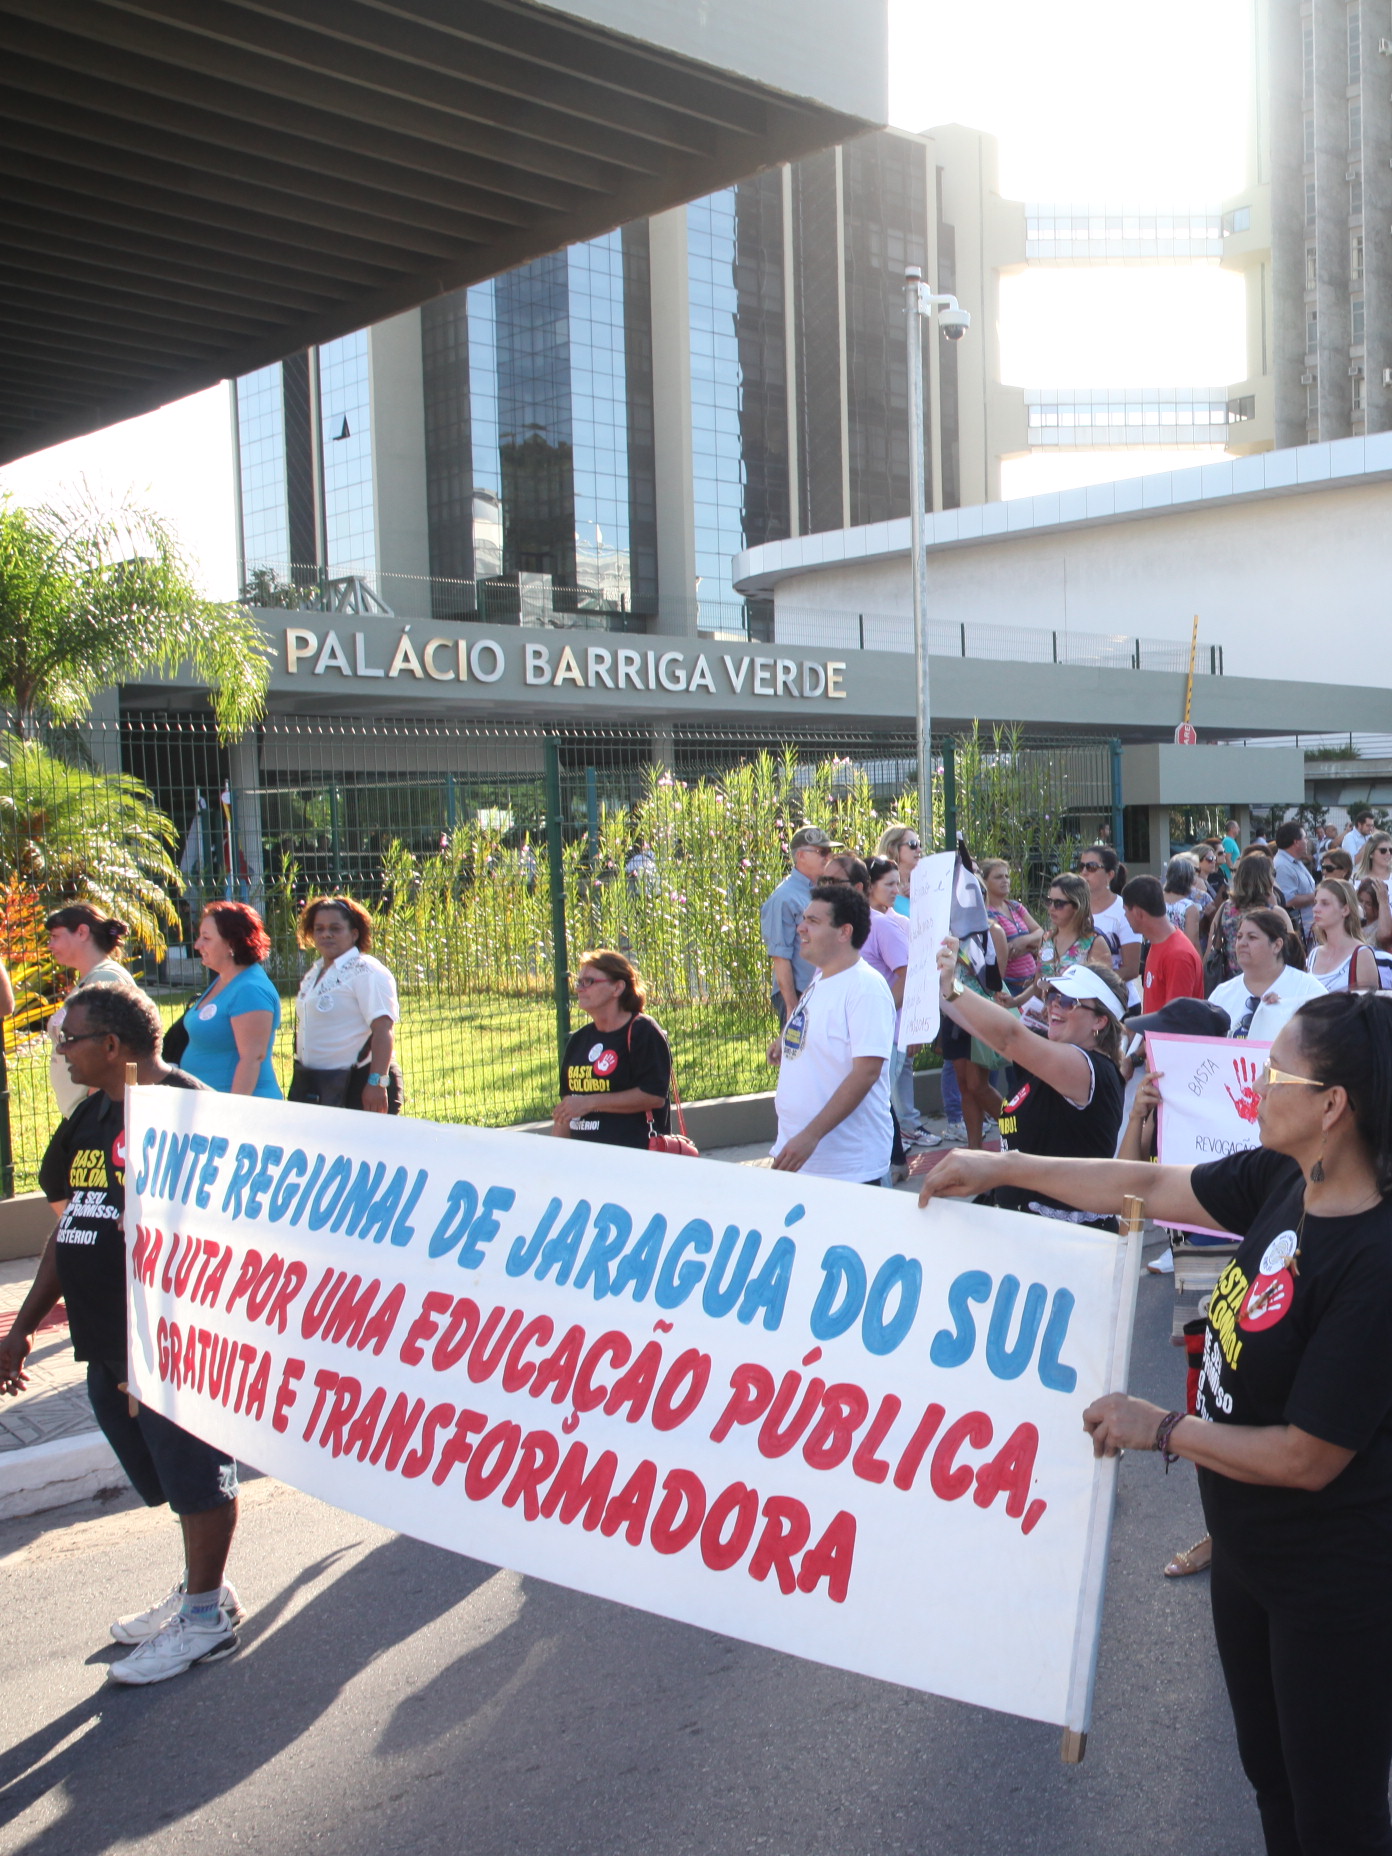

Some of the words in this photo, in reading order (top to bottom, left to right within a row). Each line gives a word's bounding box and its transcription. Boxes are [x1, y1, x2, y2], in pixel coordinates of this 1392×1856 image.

[285, 625, 505, 682] PALÁCIO
[525, 643, 716, 693] BARRIGA
[722, 654, 848, 698] VERDE
[1183, 725, 1191, 744] ARE
[1187, 1057, 1221, 1097] BASTA
[136, 1126, 229, 1210] SINTE
[222, 1142, 429, 1248] REGIONAL
[428, 1180, 516, 1270] DE
[505, 1196, 806, 1331] JARAGUÁ
[810, 1245, 923, 1356] DO
[930, 1270, 1078, 1394] SUL
[131, 1223, 164, 1289] NA
[161, 1232, 233, 1304] LUTA
[225, 1248, 307, 1335] POR
[301, 1267, 406, 1356] UMA
[400, 1291, 711, 1435] EDUCAÇÃO
[710, 1346, 1048, 1536] PÚBLICA,
[156, 1316, 272, 1422] GRATUITA
[272, 1358, 306, 1434] E
[302, 1369, 857, 1604] TRANSFORMADORA
